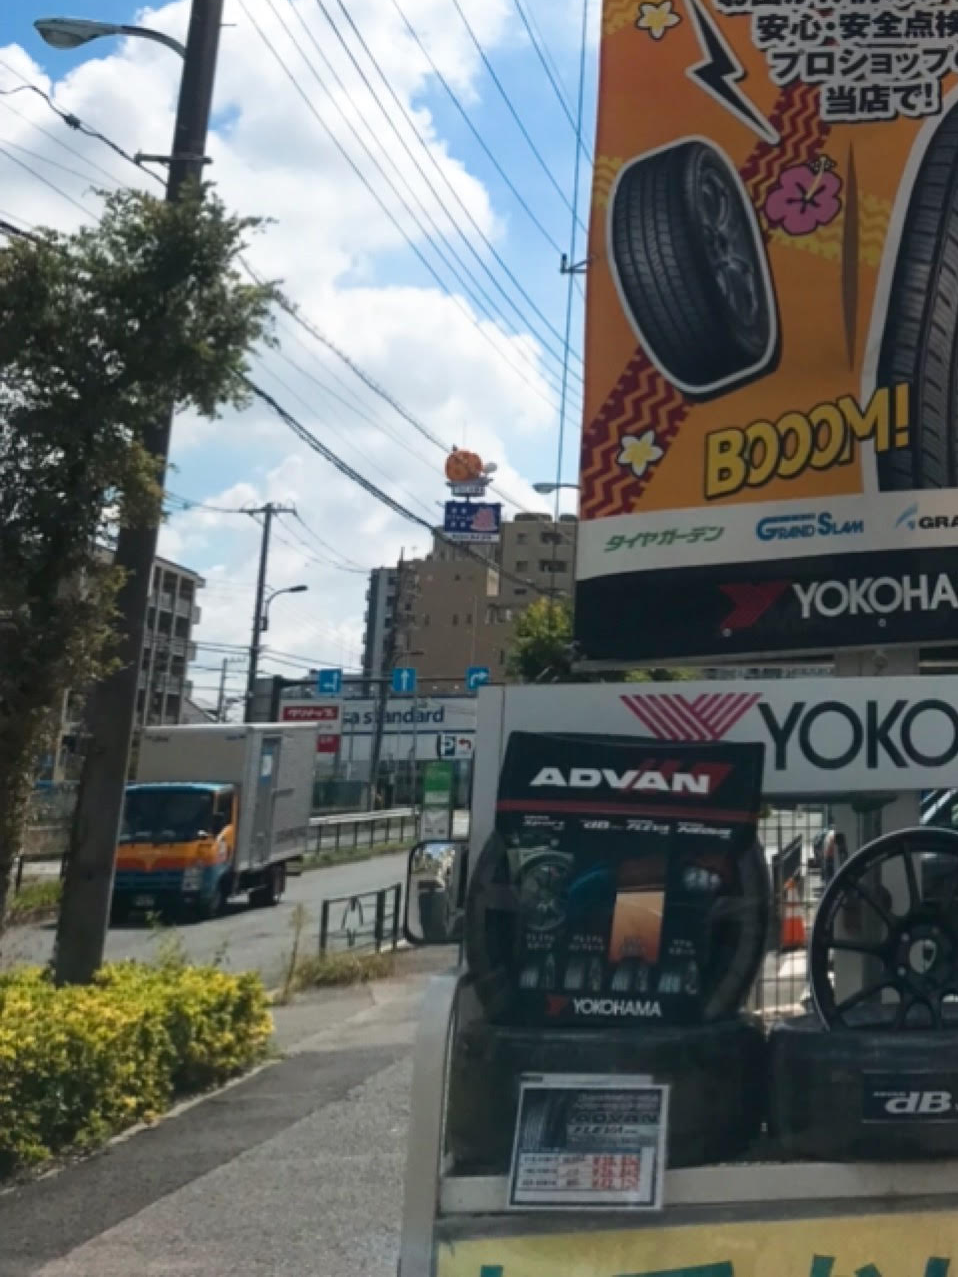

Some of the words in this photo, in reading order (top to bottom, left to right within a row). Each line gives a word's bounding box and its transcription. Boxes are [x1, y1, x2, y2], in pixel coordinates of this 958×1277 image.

[705, 382, 911, 500] BOOOM!
[603, 525, 725, 553] タイヤガーデン
[363, 705, 445, 725] sandard
[530, 767, 710, 794] ADVAN
[572, 998, 663, 1018] YOKOHAMA
[884, 1090, 952, 1114] dB
